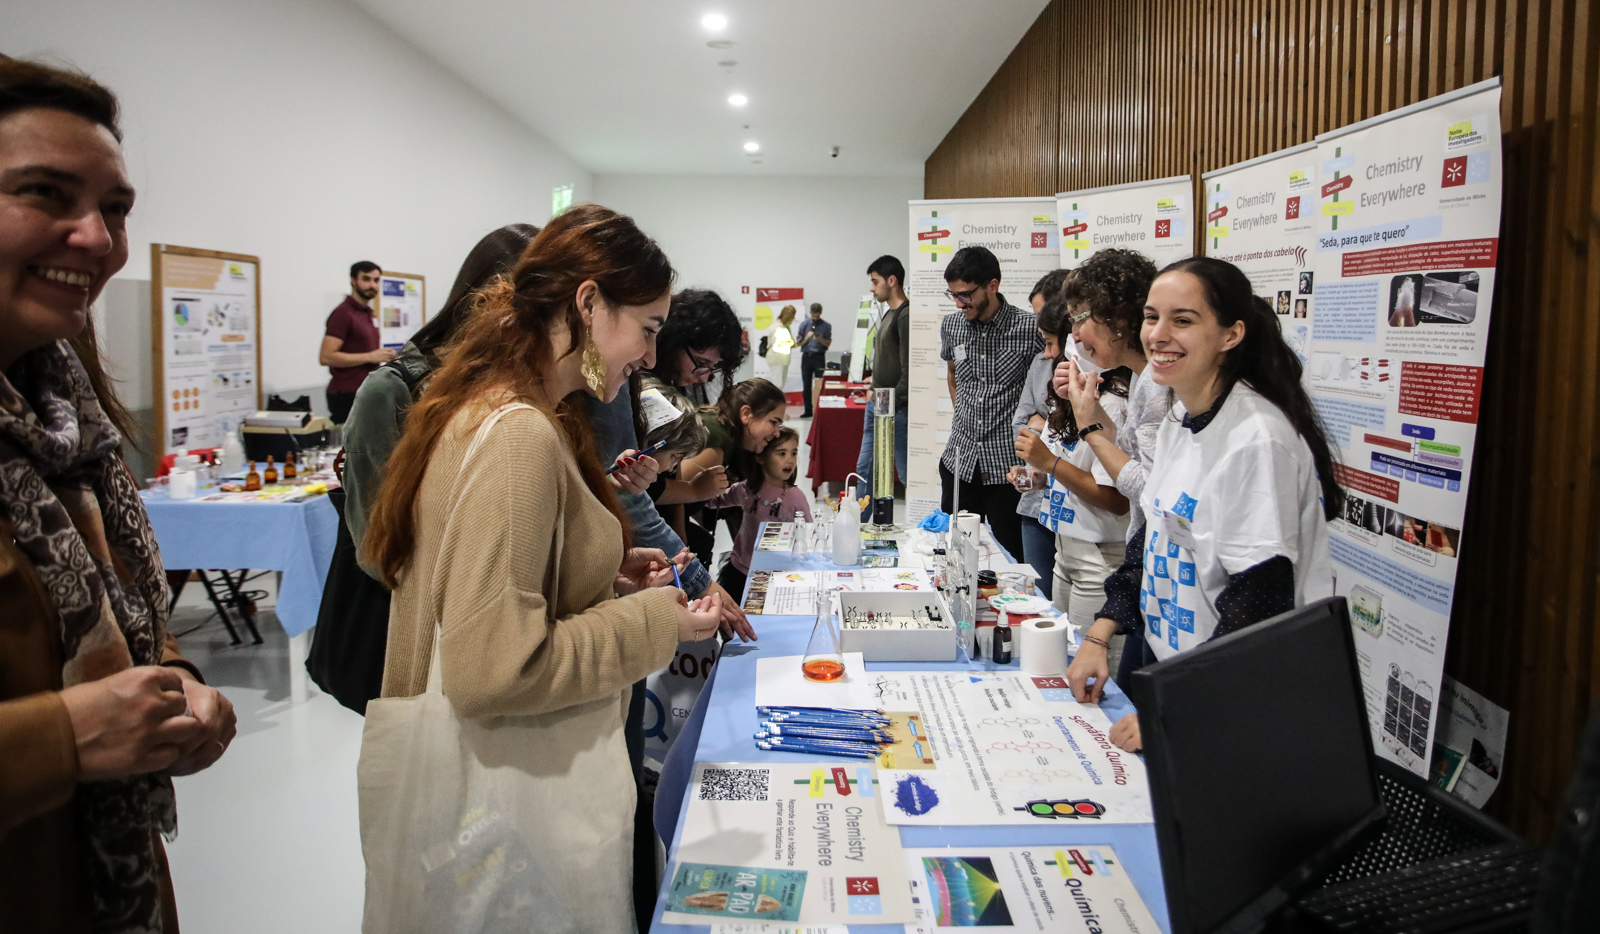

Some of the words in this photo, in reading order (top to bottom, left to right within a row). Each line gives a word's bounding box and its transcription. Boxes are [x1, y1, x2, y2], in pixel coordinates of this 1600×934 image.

[1366, 155, 1423, 180] Chemistry
[1326, 182, 1344, 193] Chemistry
[1360, 182, 1426, 207] Everywhere
[1237, 191, 1276, 209] Chemistry
[962, 224, 1017, 235] Chemistry
[1097, 213, 1142, 226] Chemistry
[1233, 213, 1278, 231] Everywhere
[1094, 232, 1145, 245] Everywhere
[1341, 235, 1358, 248] para
[1360, 234, 1372, 245] que
[1373, 232, 1380, 241] te
[1234, 253, 1242, 262] até
[1246, 252, 1262, 262] ponta
[1264, 250, 1272, 258] dos
[1420, 442, 1458, 453] Biocompatibilidade
[1420, 455, 1458, 466] Biodegradabilidade
[1052, 716, 1080, 752] Departamento
[1075, 751, 1086, 760] de
[1081, 760, 1102, 785] Química
[1068, 715, 1112, 750] Semáforo
[1105, 751, 1130, 786] Químico
[837, 772, 846, 788] Chemistry
[981, 767, 990, 780] oxidada
[988, 787, 999, 800] índigo
[788, 799, 796, 819] Responde
[776, 827, 784, 848] fantástico
[812, 803, 835, 866] Everywhere
[845, 806, 866, 862] Chemistry
[775, 850, 783, 860] livro
[788, 842, 796, 866] habilita-te
[1021, 851, 1037, 876] Química
[1071, 850, 1088, 871] Chemistry
[734, 872, 757, 887] AR
[1033, 876, 1044, 888] das
[728, 893, 754, 914] PÃO
[1038, 889, 1055, 921] nuvens...
[1064, 878, 1103, 934] Química
